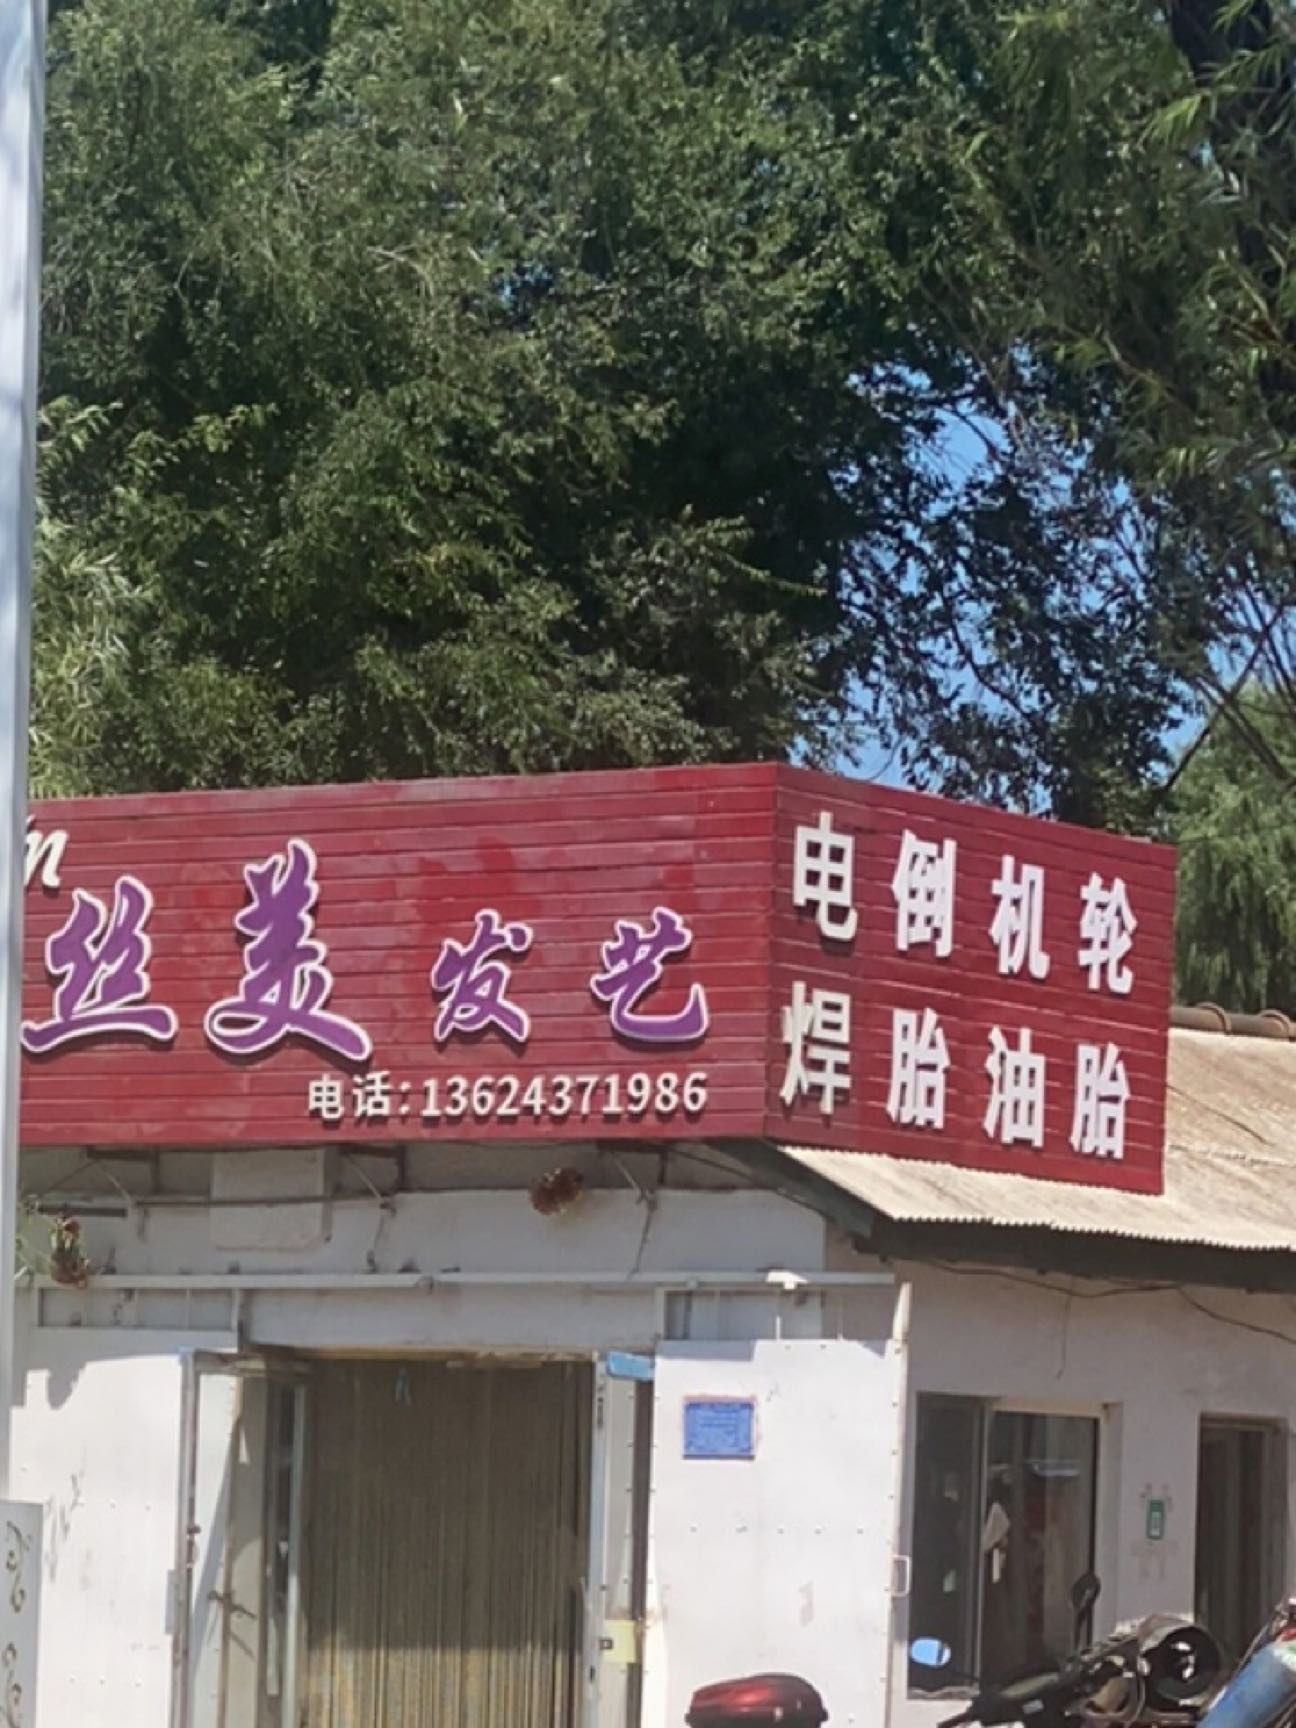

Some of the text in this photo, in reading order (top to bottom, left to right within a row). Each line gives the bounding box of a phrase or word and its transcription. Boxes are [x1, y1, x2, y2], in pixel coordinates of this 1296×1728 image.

[308, 1071, 707, 1120] 电话:13624371986
[780, 811, 858, 1115] 电焊
[983, 854, 1050, 1148] 机油
[1070, 871, 1138, 1160] 轮胎
